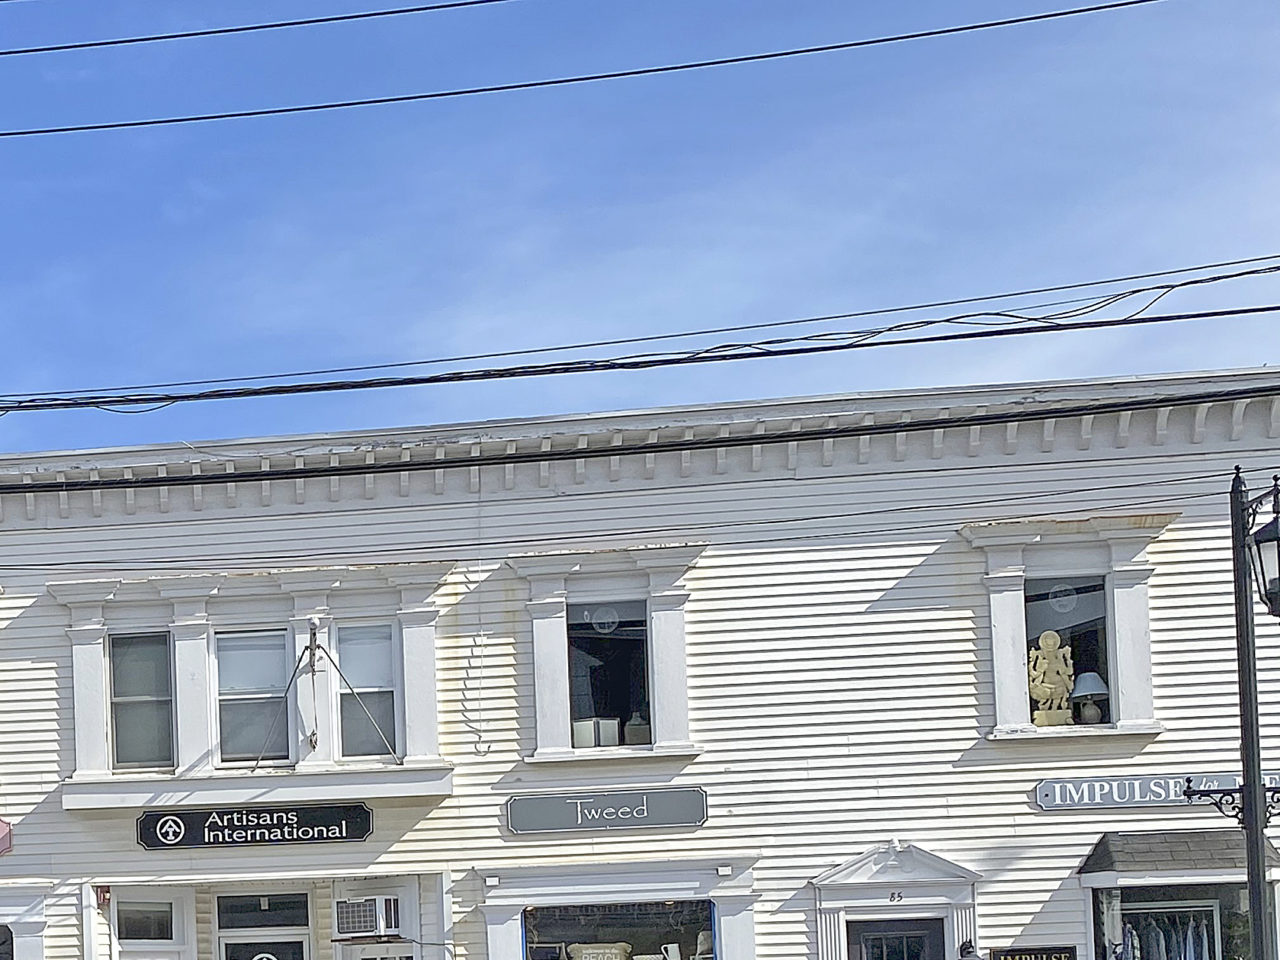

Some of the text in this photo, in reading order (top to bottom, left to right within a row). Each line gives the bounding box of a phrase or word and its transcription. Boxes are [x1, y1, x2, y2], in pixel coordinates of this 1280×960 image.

[1052, 778, 1185, 805] IMPULSE
[205, 810, 298, 827] Artisans
[566, 795, 648, 824] Tweed
[204, 820, 347, 842] International
[889, 892, 903, 902] 85
